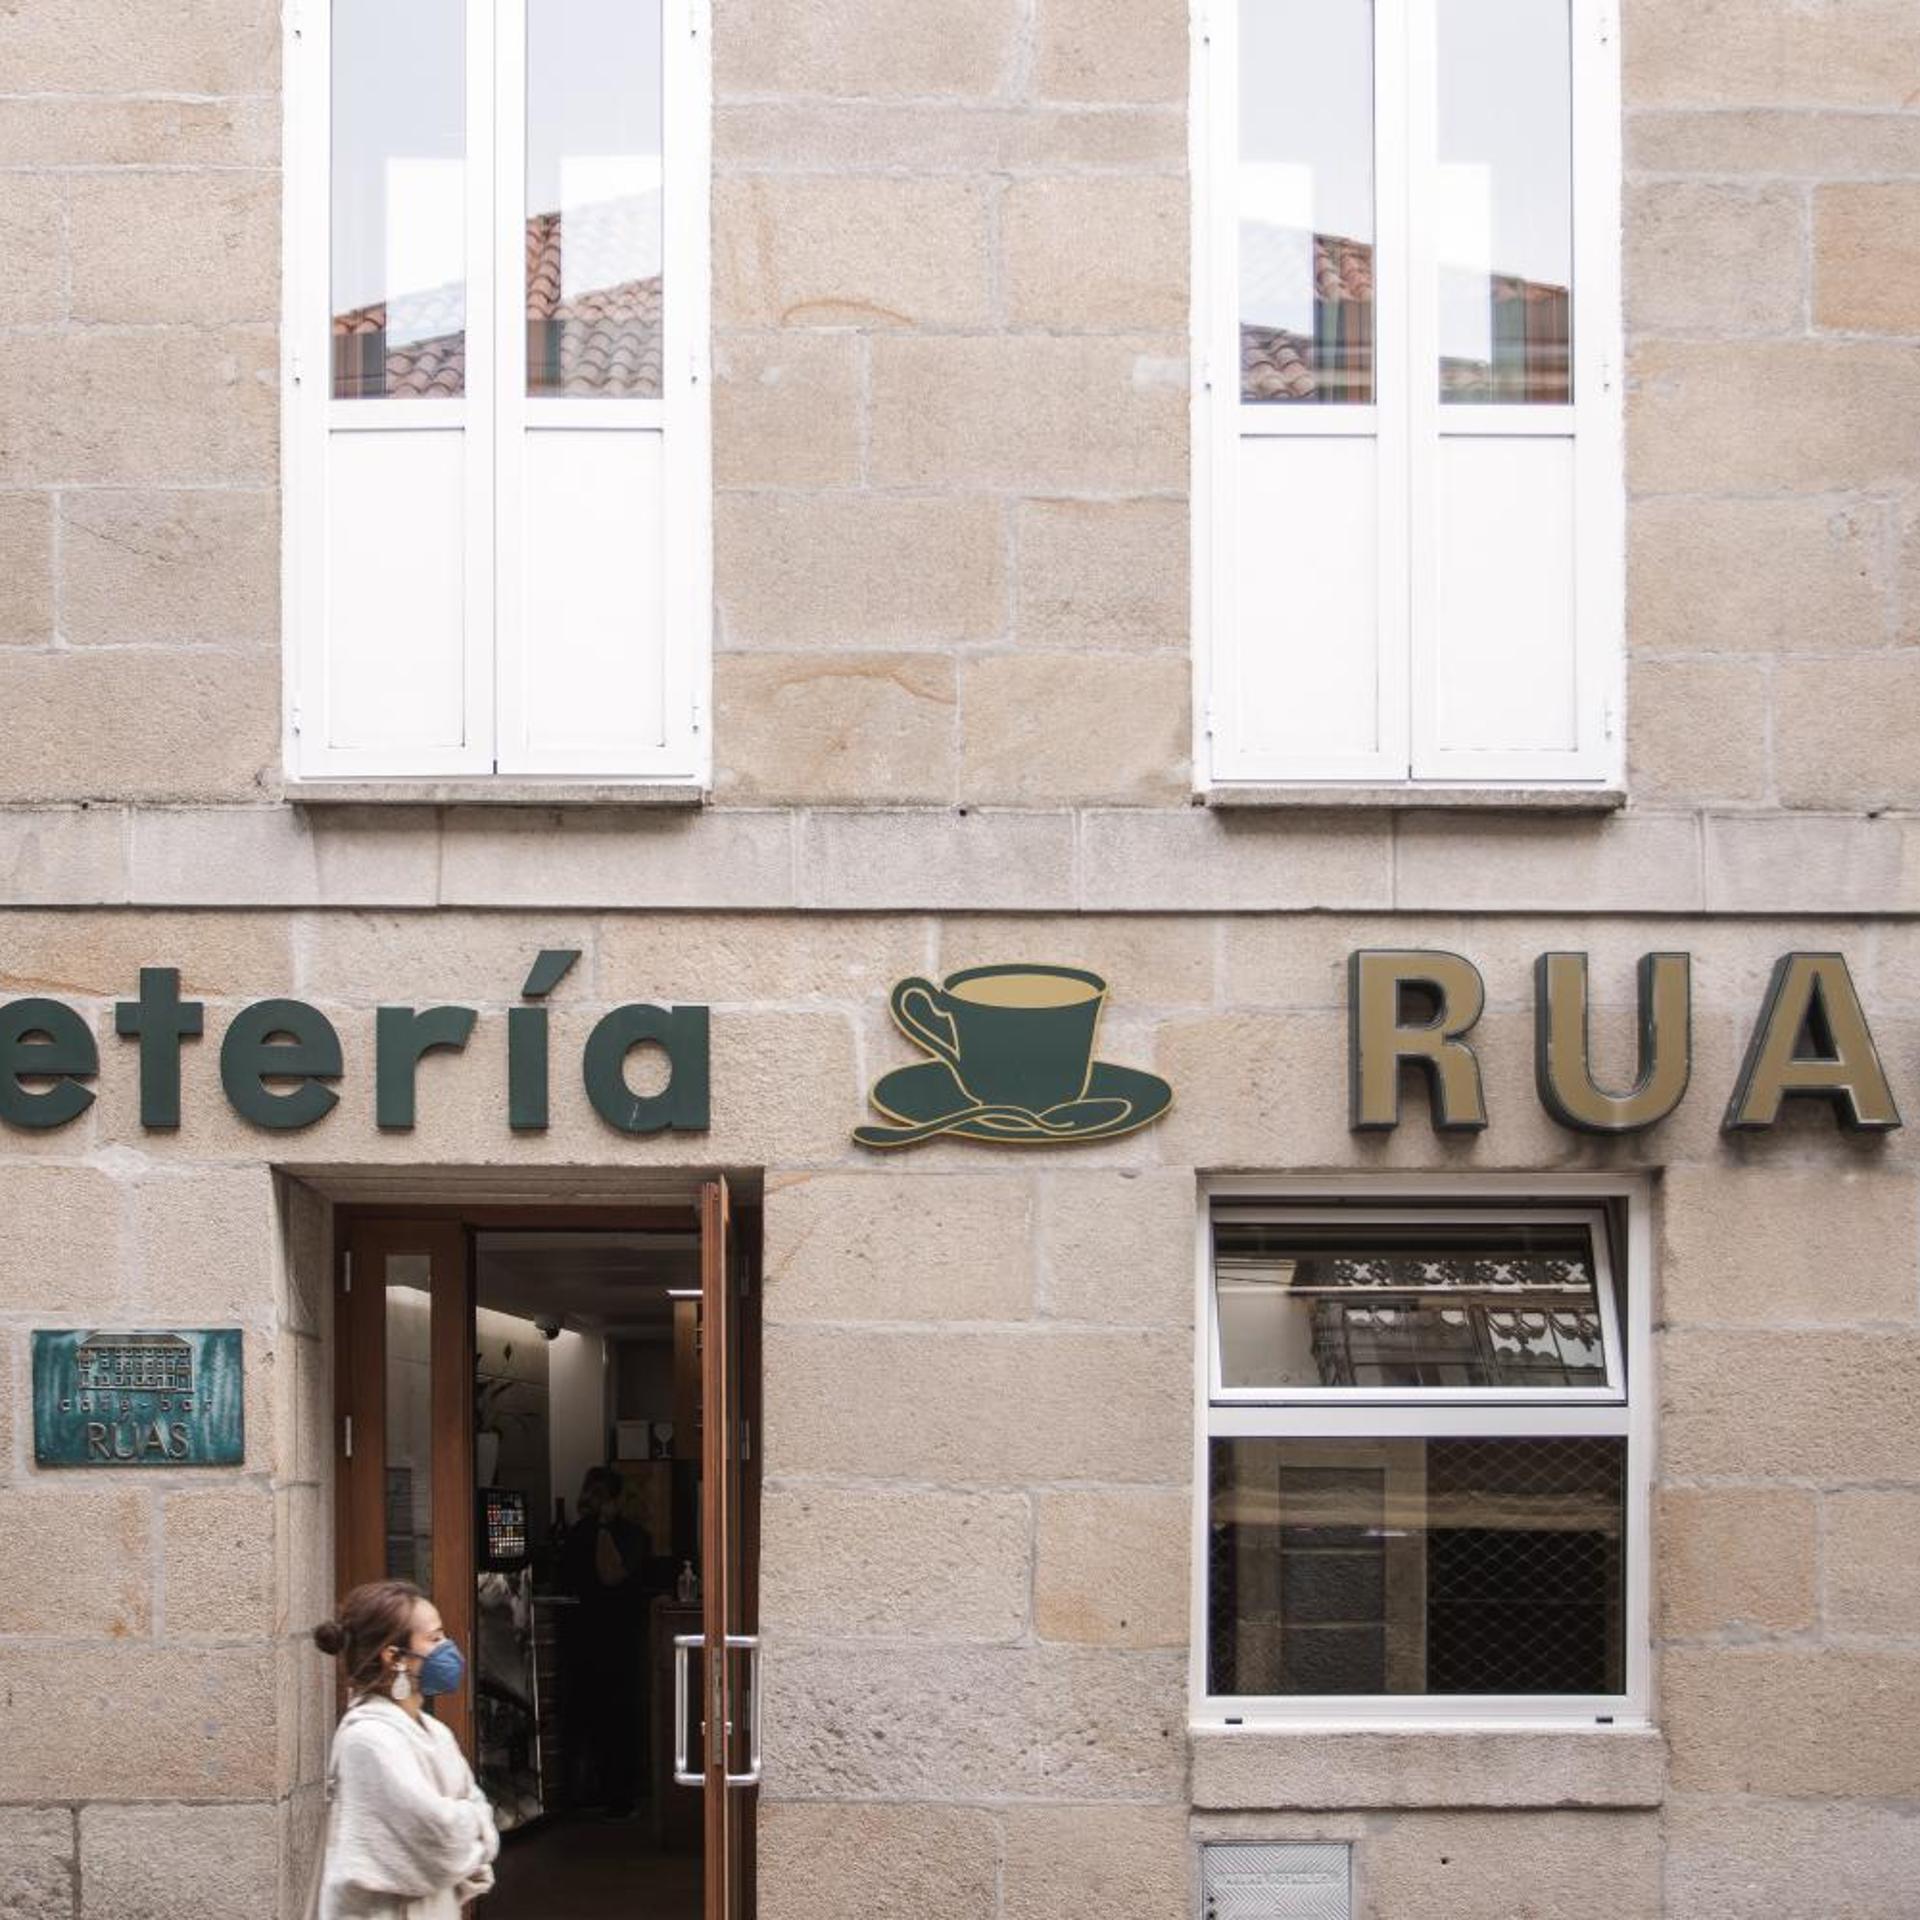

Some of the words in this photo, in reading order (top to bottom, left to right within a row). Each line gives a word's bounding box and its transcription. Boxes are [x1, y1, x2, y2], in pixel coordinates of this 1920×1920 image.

[0, 949, 711, 1133] etería
[1348, 949, 1903, 1135] RUA
[87, 1421, 190, 1459] RUAS
